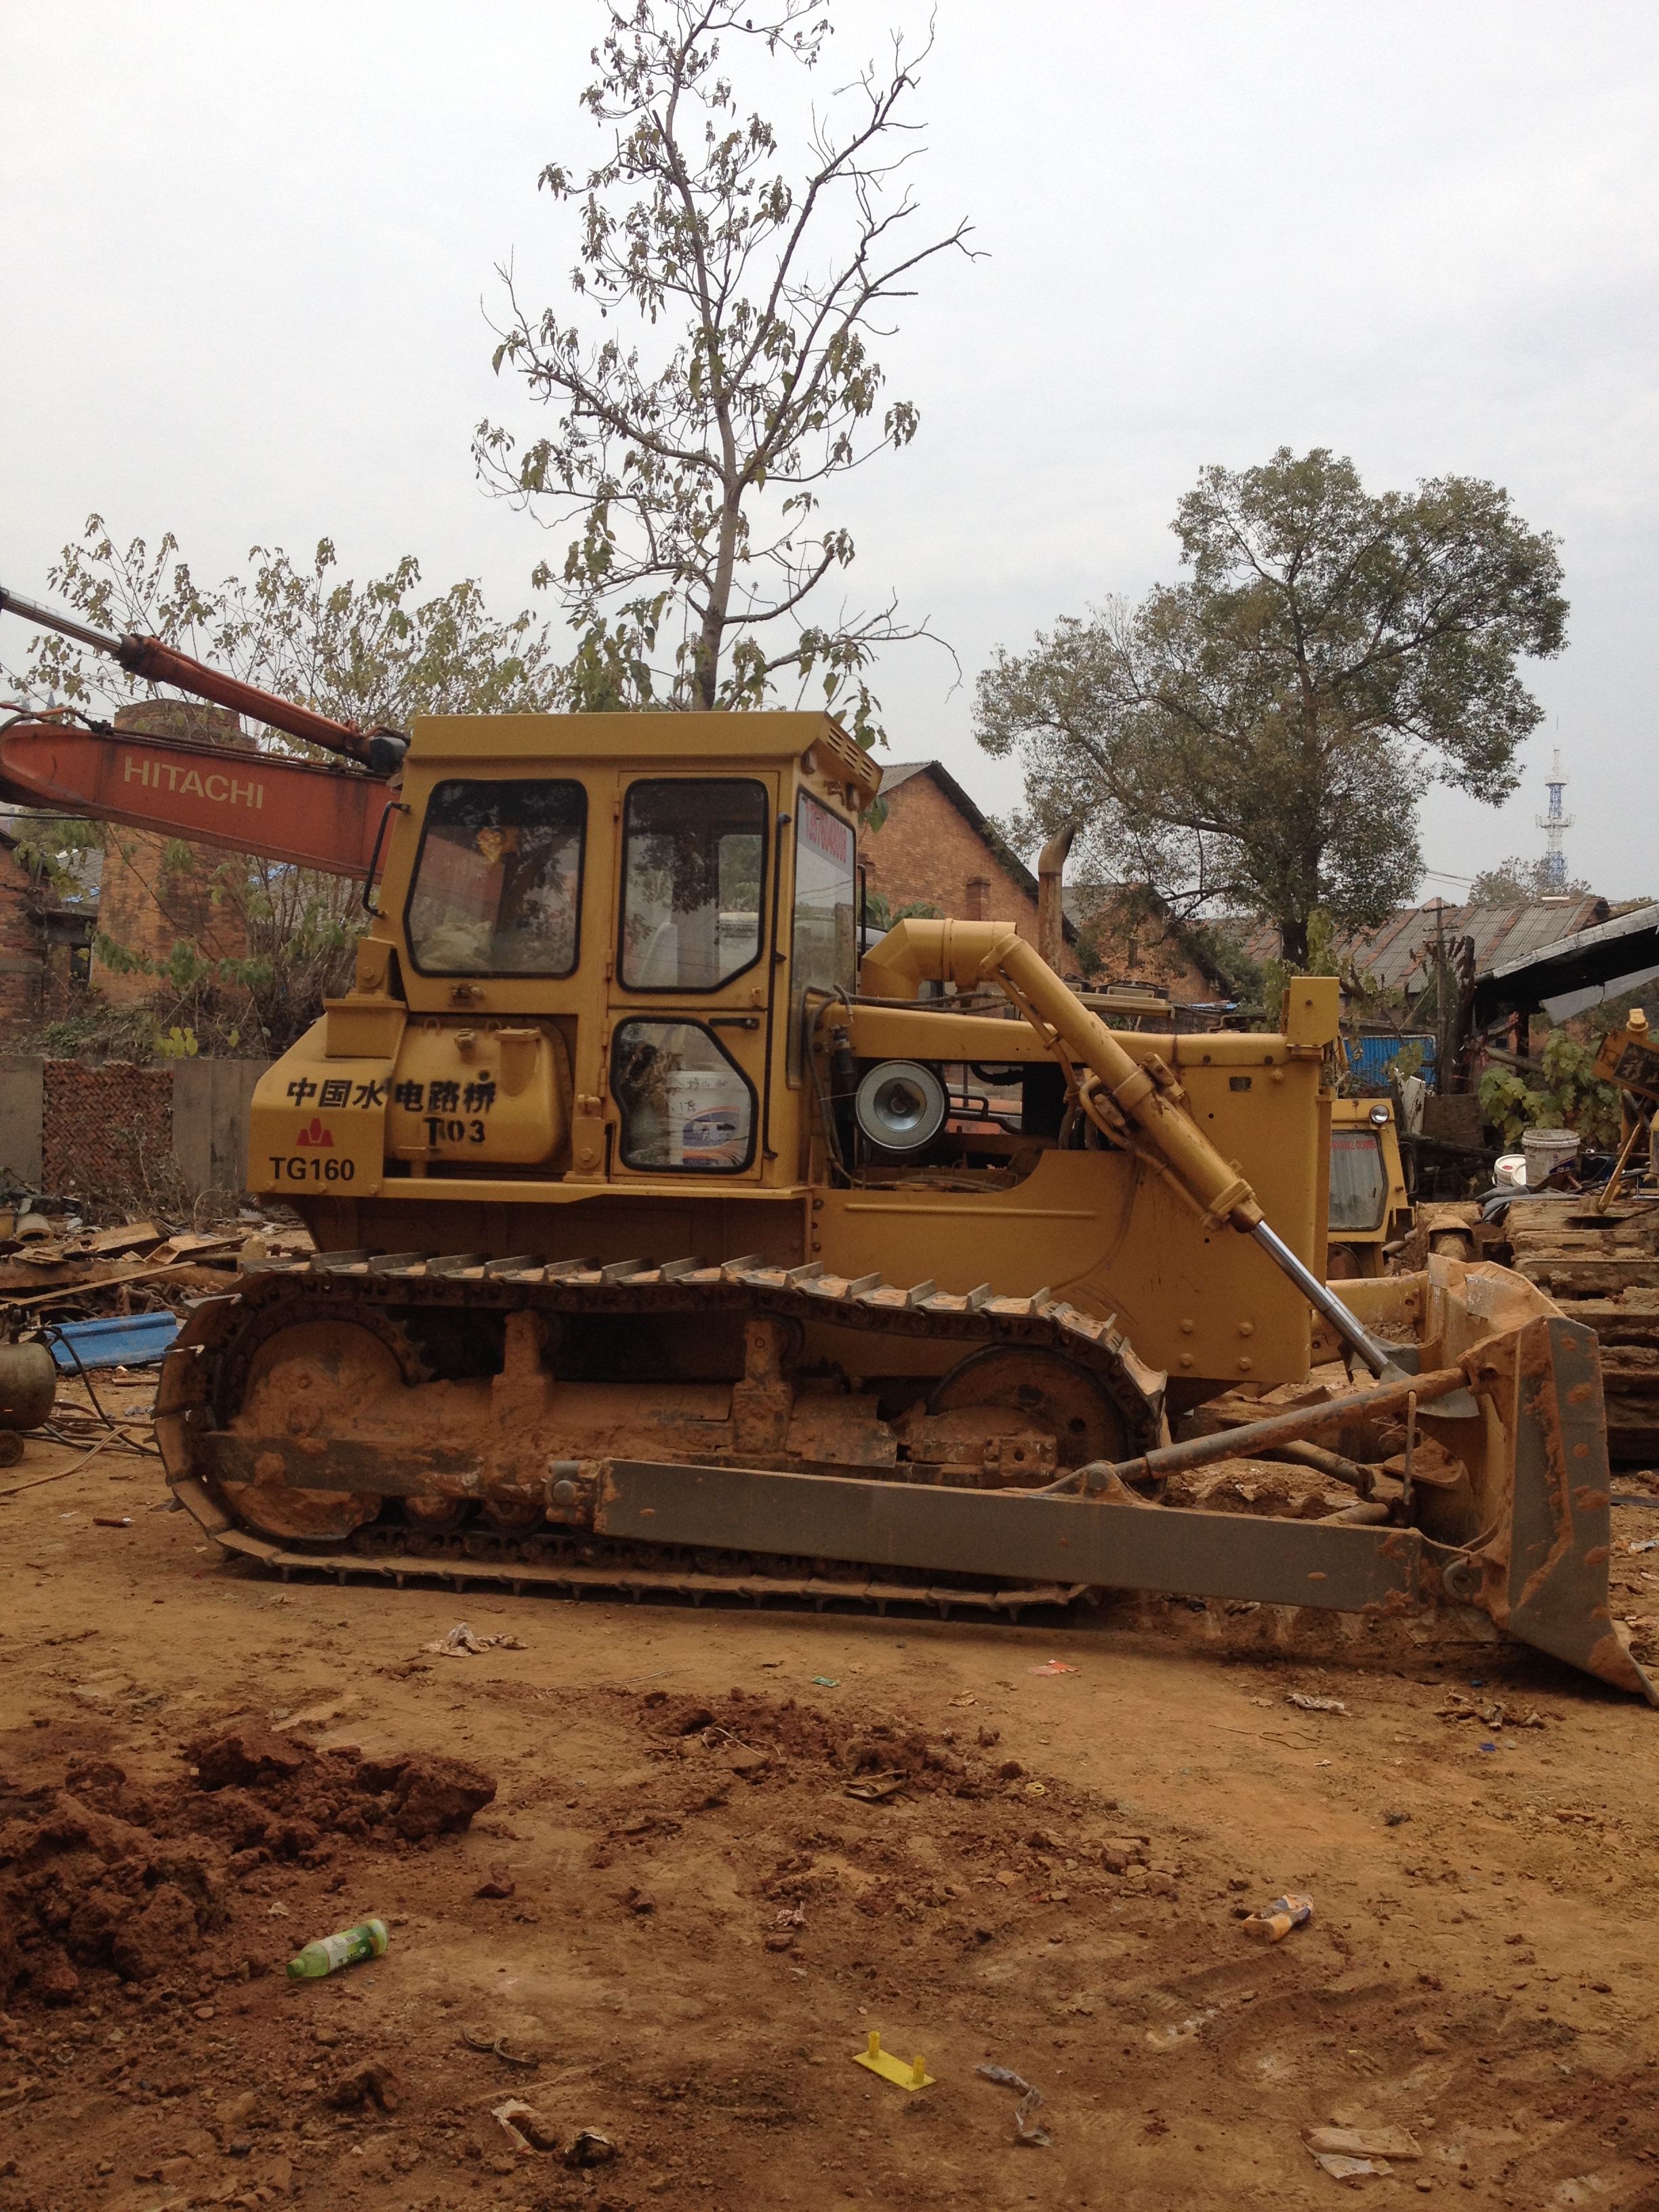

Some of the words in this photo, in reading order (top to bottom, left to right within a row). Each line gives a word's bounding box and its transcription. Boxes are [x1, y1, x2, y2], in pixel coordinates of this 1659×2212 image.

[124, 756, 264, 809] HITACHI
[287, 1078, 496, 1113] 中国水电路桥
[269, 1157, 354, 1181] TG160
